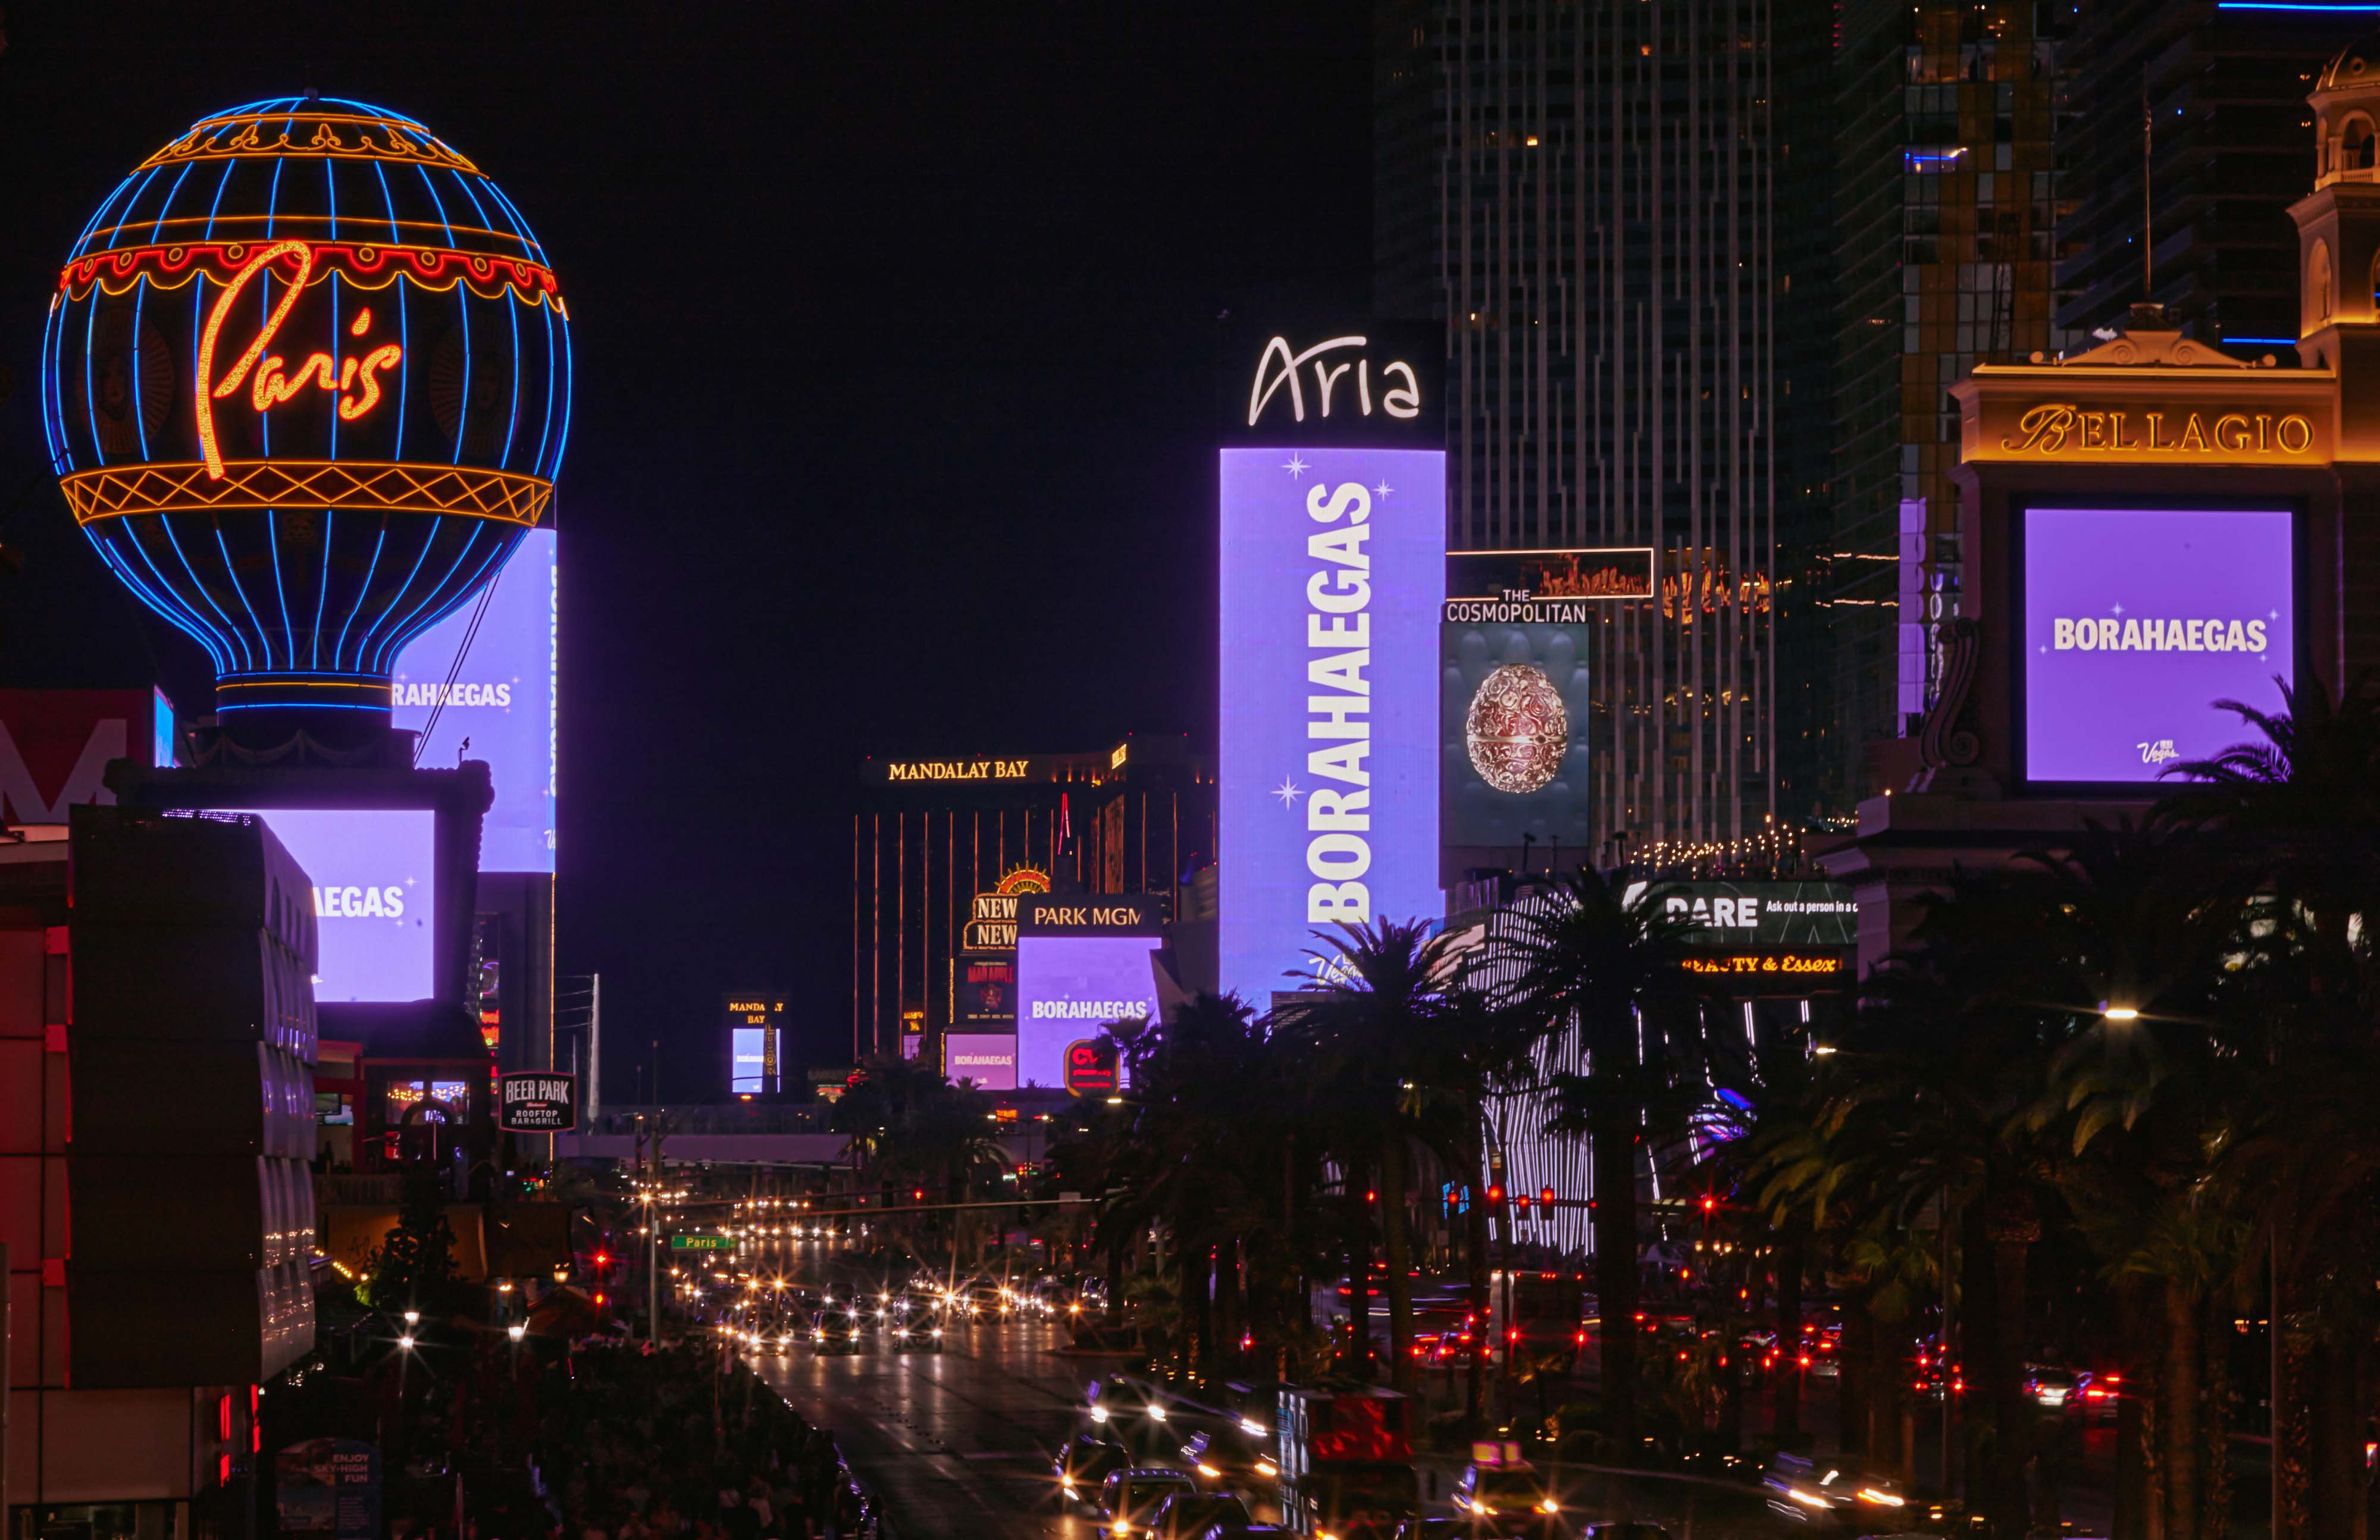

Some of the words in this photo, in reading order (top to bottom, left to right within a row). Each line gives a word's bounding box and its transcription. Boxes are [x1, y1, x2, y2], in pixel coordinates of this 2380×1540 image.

[196, 240, 402, 480] Paris
[1248, 335, 1420, 426] Aria
[2001, 403, 2315, 455] BELLAGIO
[1503, 589, 1530, 603] THE
[1446, 603, 1586, 623] COSMOPOLITAN
[2054, 618, 2268, 653] BORAHAEGAS
[1306, 481, 1371, 924] BORAHAEGAS
[888, 763, 989, 780] MANDALAY
[994, 760, 1029, 778] BAY
[978, 898, 1017, 918] NEW
[1034, 907, 1087, 926] PARK
[1093, 907, 1142, 926] MGM
[1766, 900, 1782, 912] Ask
[1784, 901, 1797, 912] out
[1799, 903, 1805, 912] a
[1806, 902, 1834, 914] person
[1836, 900, 1844, 912] in
[1846, 903, 1851, 912] a
[978, 924, 1017, 945] NEW
[1762, 958, 1778, 972] &
[1781, 955, 1836, 973] Essex
[729, 1002, 784, 1011] MANDAY
[1032, 1000, 1147, 1019] BORAHAEGAS
[954, 1056, 1012, 1065] BORAHAEGAS
[506, 1080, 536, 1104] BEER
[538, 1080, 569, 1104] PARK
[686, 1237, 717, 1247] Paris
[333, 1454, 370, 1462] ENJOY
